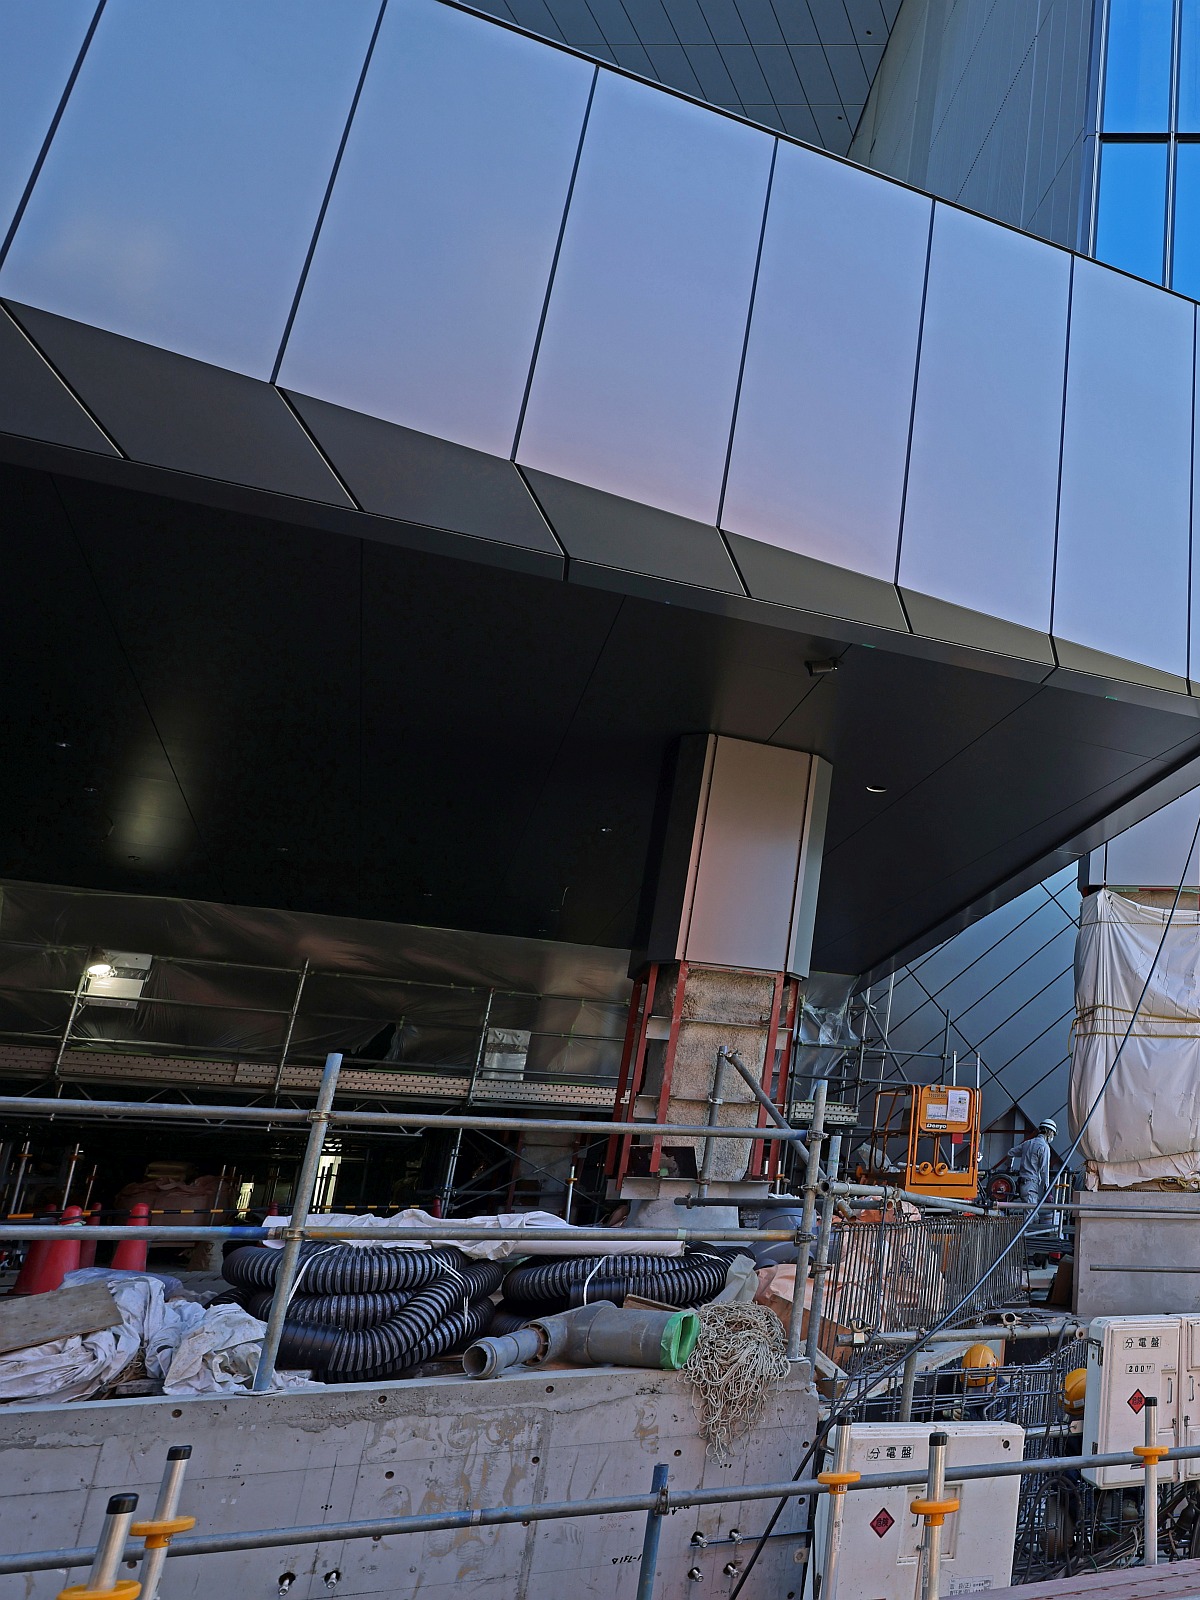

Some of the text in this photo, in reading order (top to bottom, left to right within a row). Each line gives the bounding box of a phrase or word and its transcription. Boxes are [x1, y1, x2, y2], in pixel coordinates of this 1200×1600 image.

[1125, 1337, 1160, 1349] 分電盤
[868, 1446, 913, 1460] 分電盤
[876, 1518, 889, 1528] 危険
